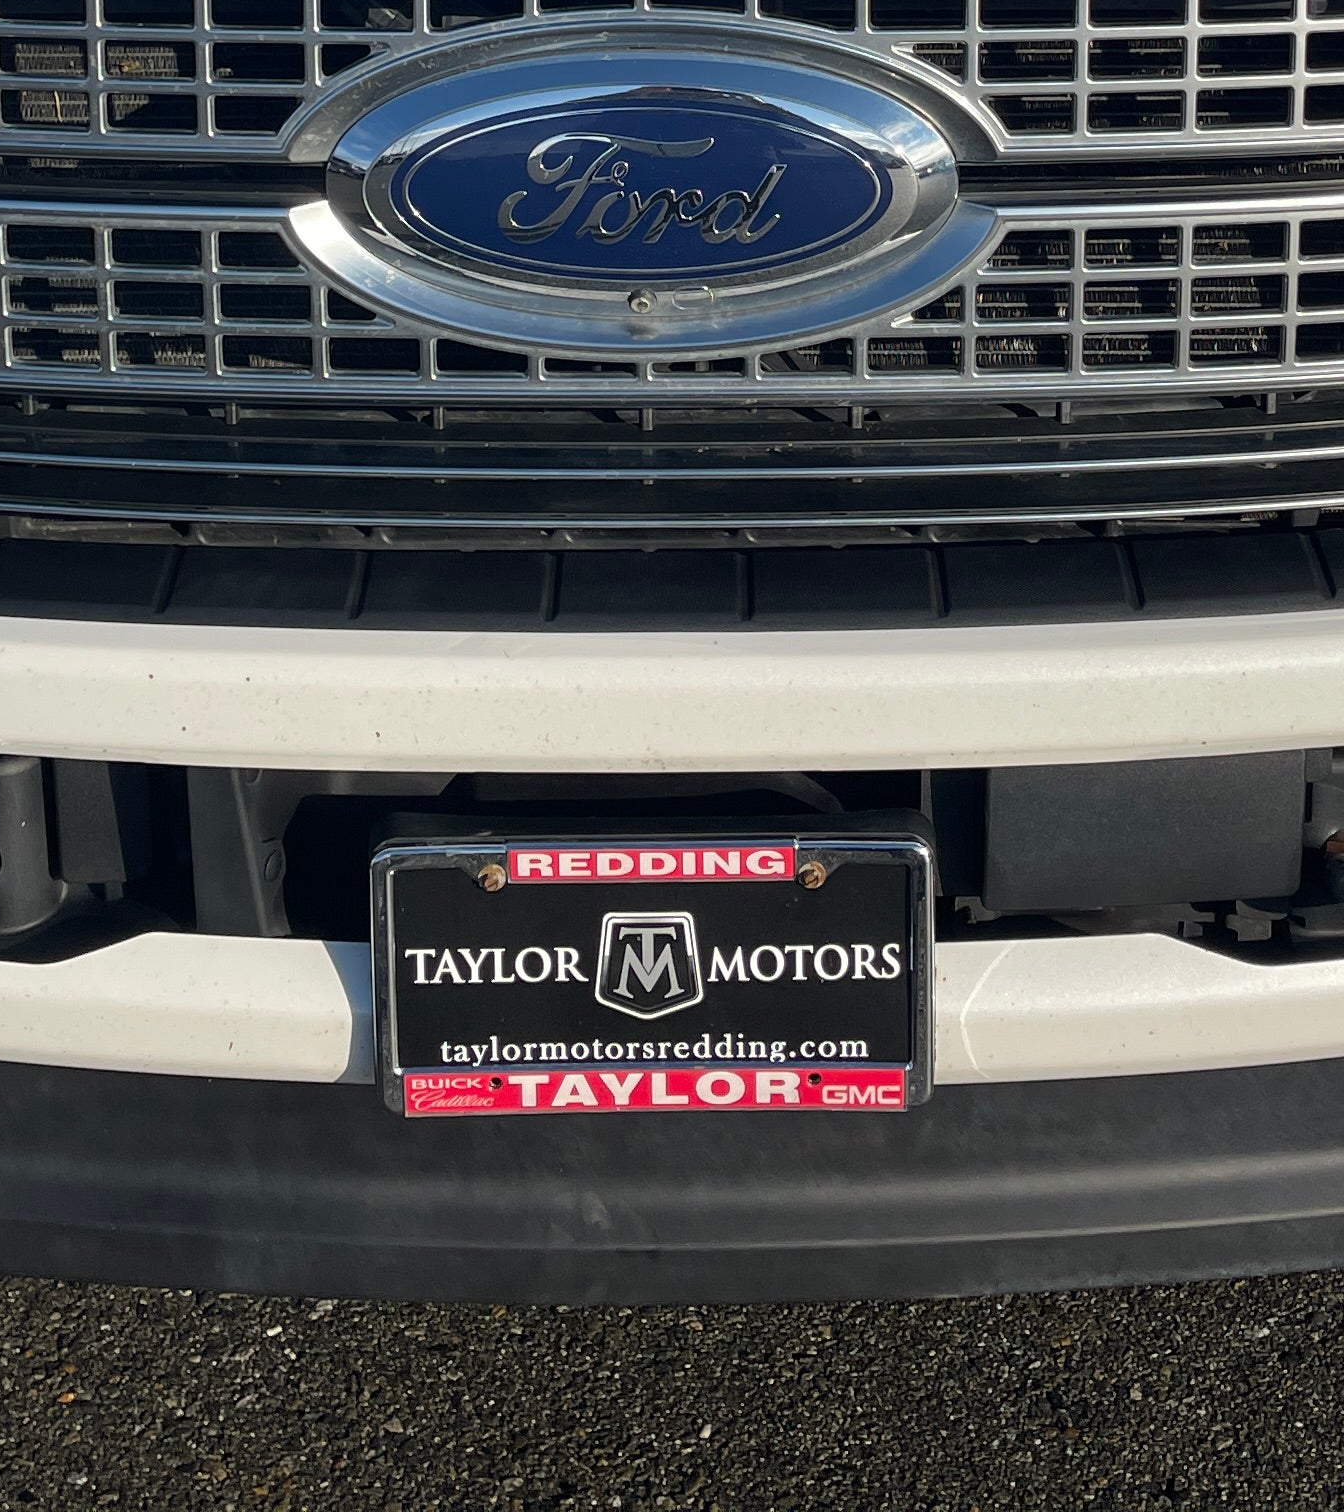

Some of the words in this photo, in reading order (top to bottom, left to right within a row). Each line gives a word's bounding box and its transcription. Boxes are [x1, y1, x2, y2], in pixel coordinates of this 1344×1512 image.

[496, 132, 788, 246] Ford
[517, 850, 786, 877] REDDING
[404, 946, 589, 985] TAYLOR
[707, 943, 901, 983] MOTORS
[440, 1033, 870, 1067] taylormotorsredding.com
[410, 1089, 495, 1111] Cadillac
[411, 1077, 483, 1090] BUICK
[507, 1071, 802, 1108] TAYLOR
[821, 1085, 901, 1105] GMC
